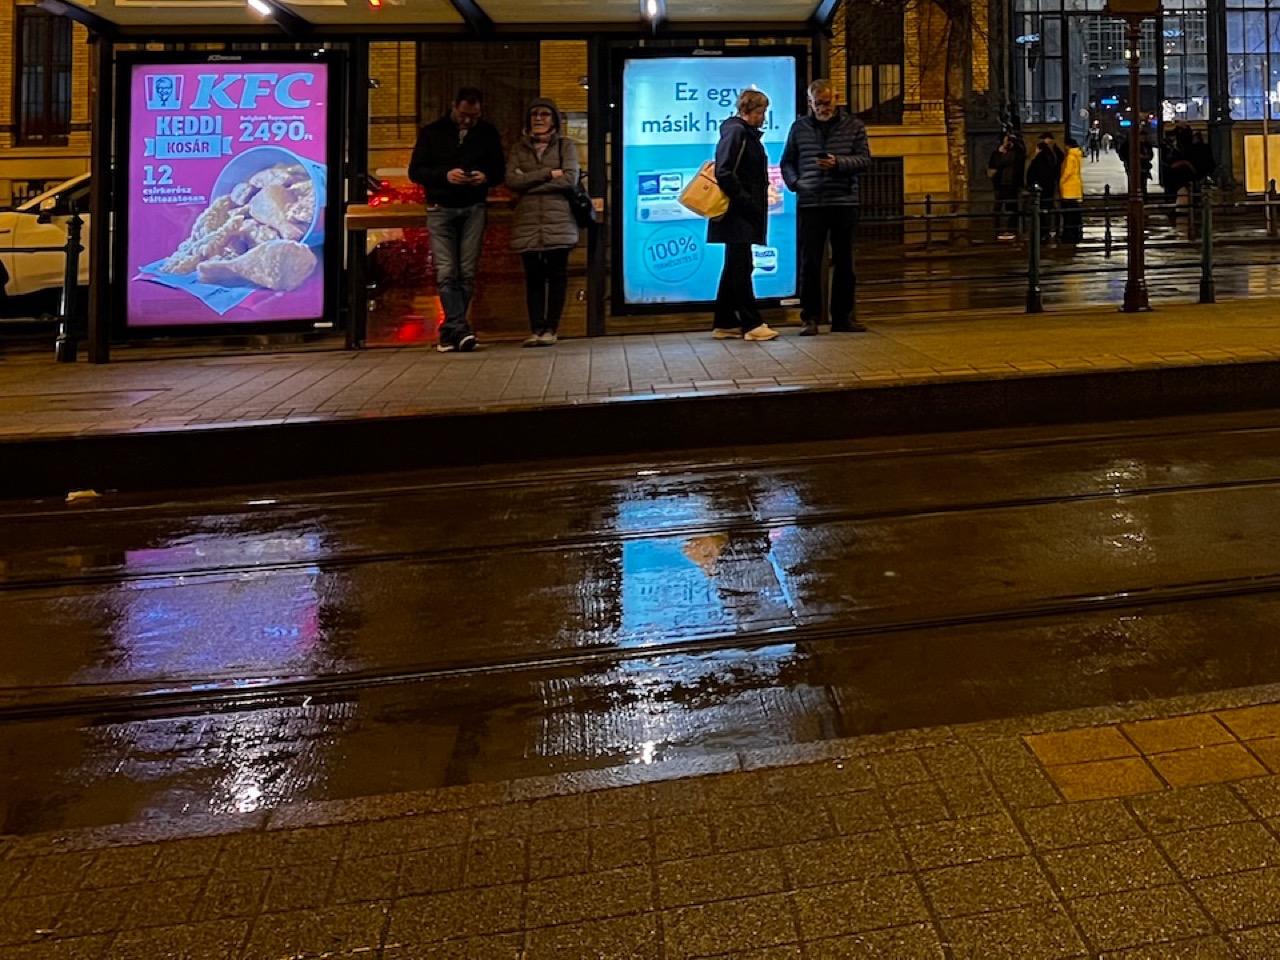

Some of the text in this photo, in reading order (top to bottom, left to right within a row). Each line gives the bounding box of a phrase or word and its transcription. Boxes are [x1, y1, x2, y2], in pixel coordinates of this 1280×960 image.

[189, 72, 314, 110] KFC
[675, 82, 699, 101] Ez
[156, 115, 223, 137] KEDDI
[239, 120, 305, 142] 2490
[642, 111, 701, 133] másik
[167, 141, 211, 154] KOSÁR
[143, 164, 174, 186] 12
[647, 235, 698, 262] 100%
